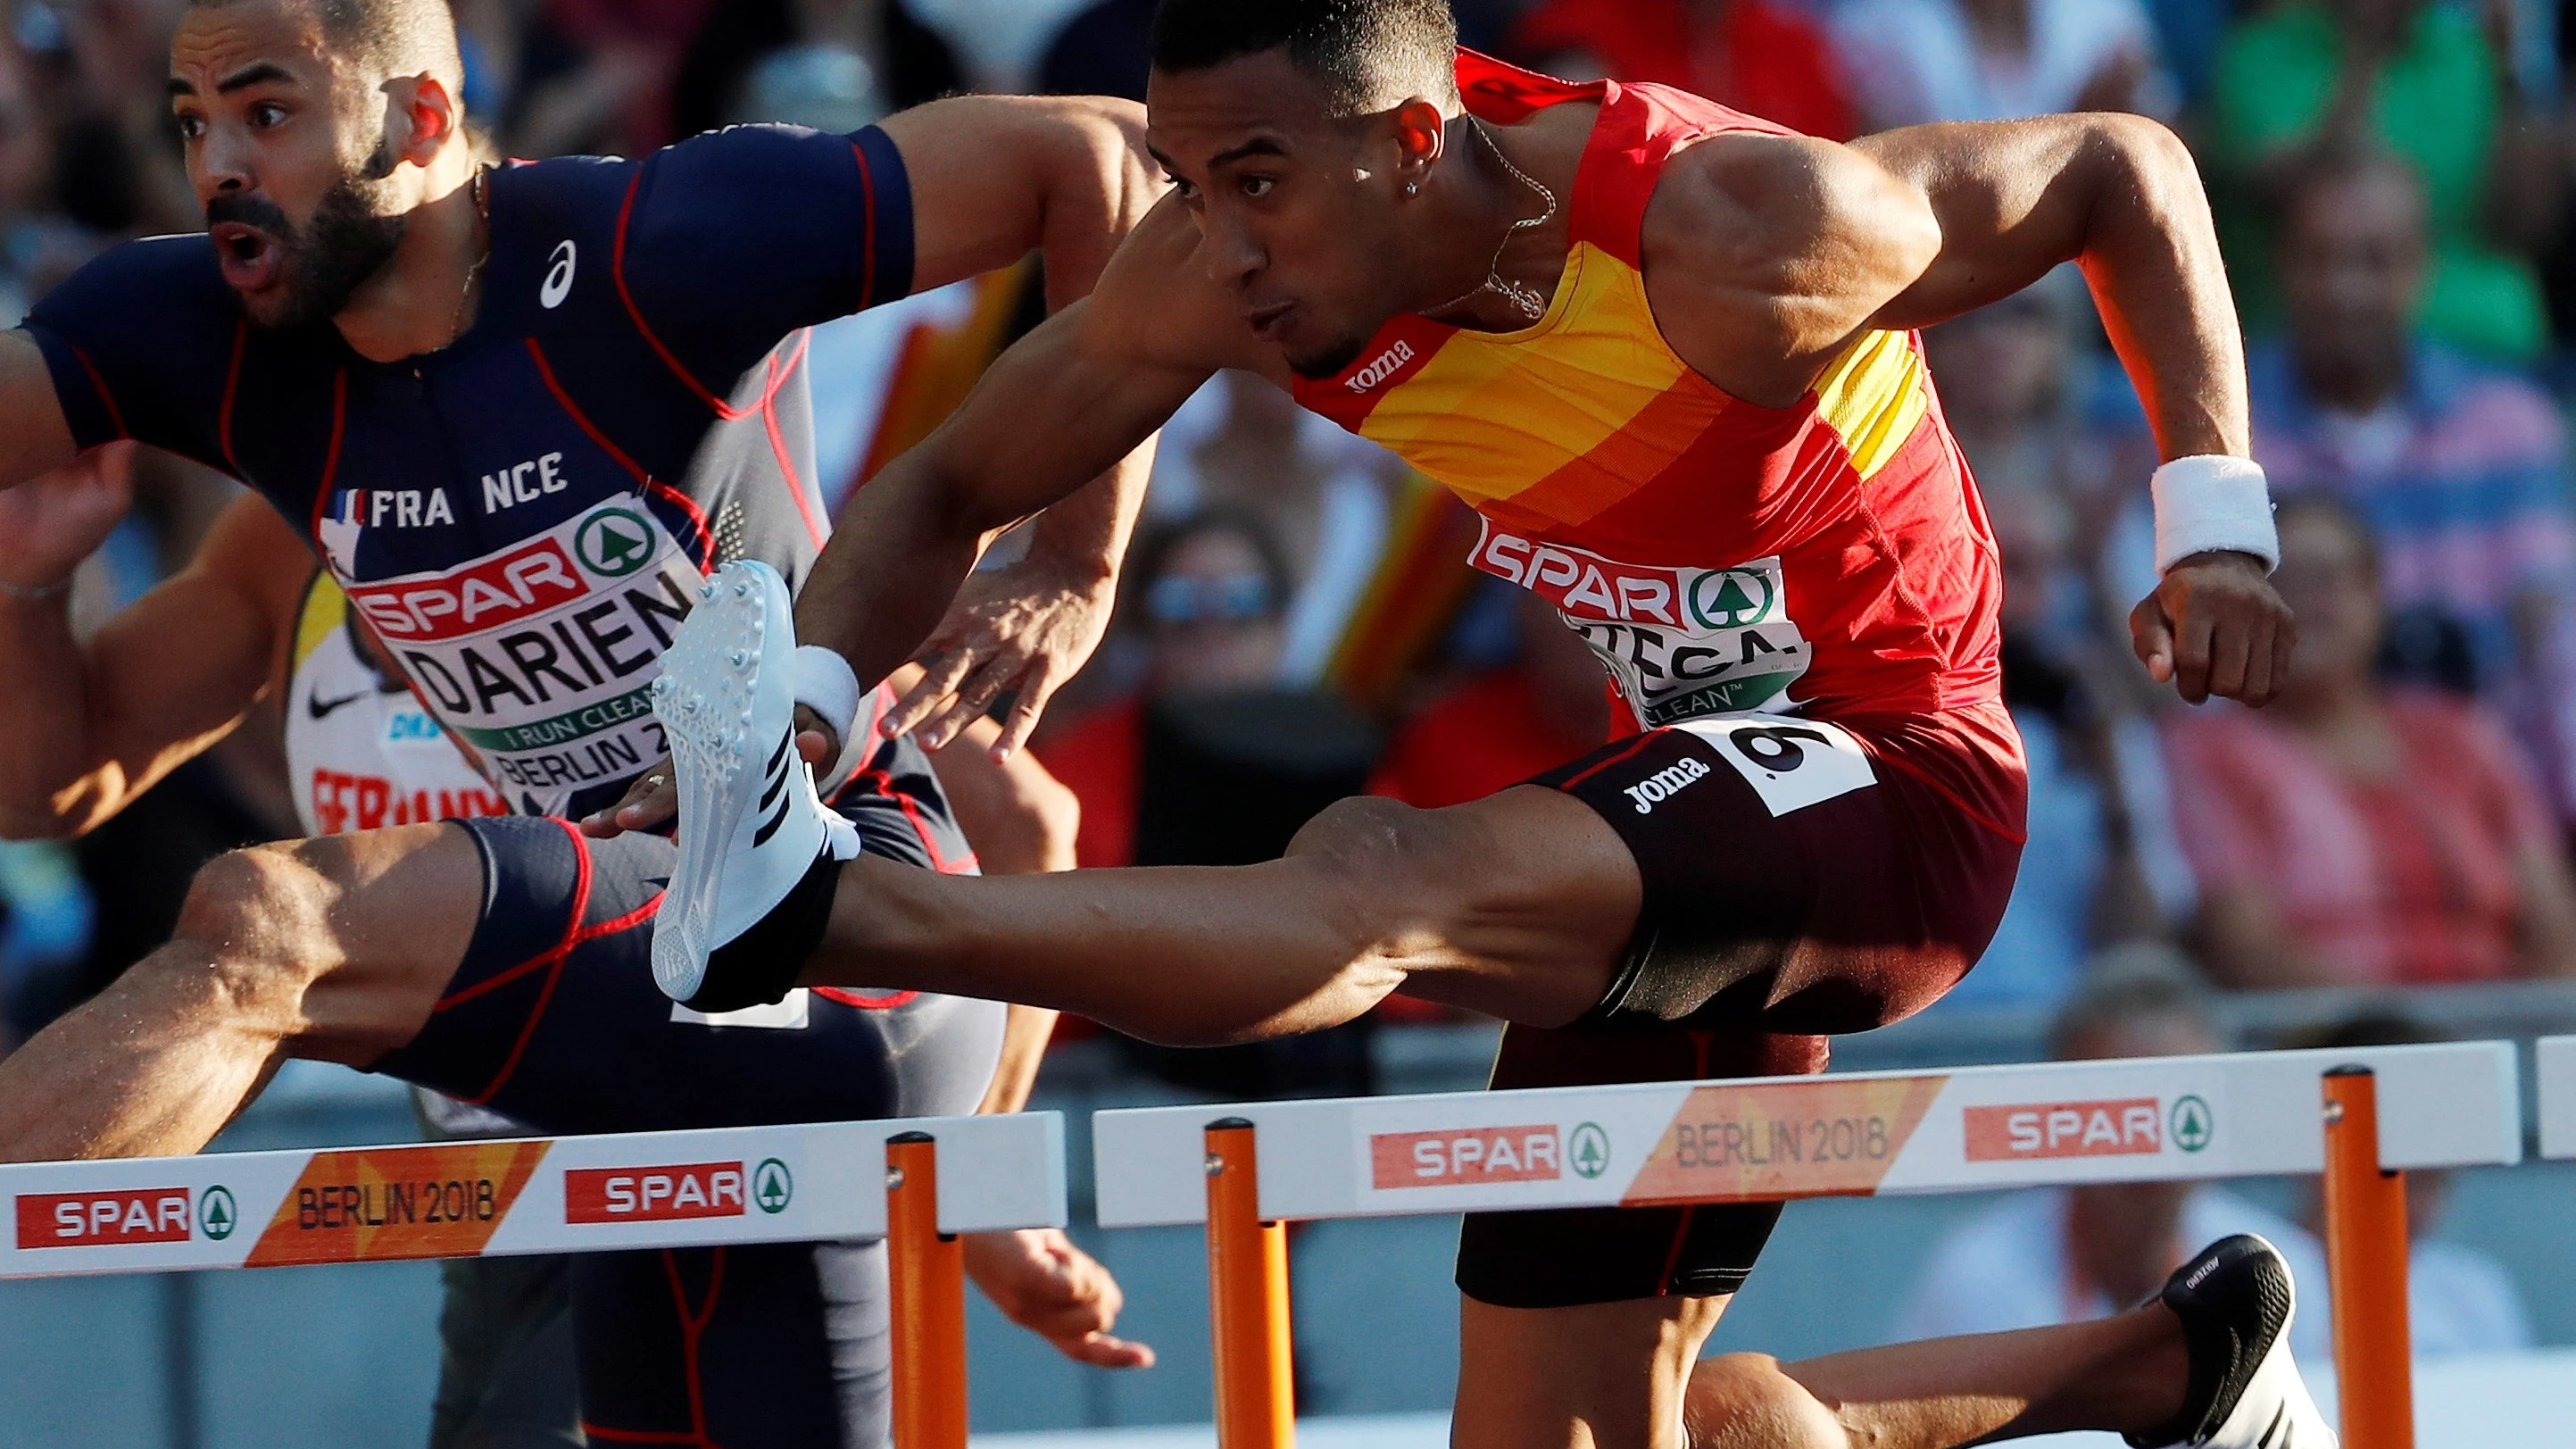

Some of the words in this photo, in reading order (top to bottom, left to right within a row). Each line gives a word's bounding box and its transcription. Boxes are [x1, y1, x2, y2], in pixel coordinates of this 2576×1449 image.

[371, 487, 455, 529] FRA
[481, 452, 569, 515] NCE
[357, 551, 576, 632] SPAR
[1486, 534, 1675, 624] SPAR
[402, 570, 694, 714] DARIEN
[495, 734, 643, 787] BERLIN
[641, 722, 670, 754] 2
[503, 732, 518, 748] I
[518, 718, 579, 745] RUN
[1624, 756, 1711, 814] Joma
[1413, 1133, 1558, 1178] SPAR
[1676, 1119, 1801, 1169] BERLIN
[1810, 1116, 1890, 1162] 2018
[2007, 1106, 2156, 1152] SPAR
[54, 1196, 189, 1237] SPAR
[299, 1182, 415, 1229] BERLIN
[424, 1179, 495, 1223] 2018
[604, 1170, 744, 1213] SPAR
